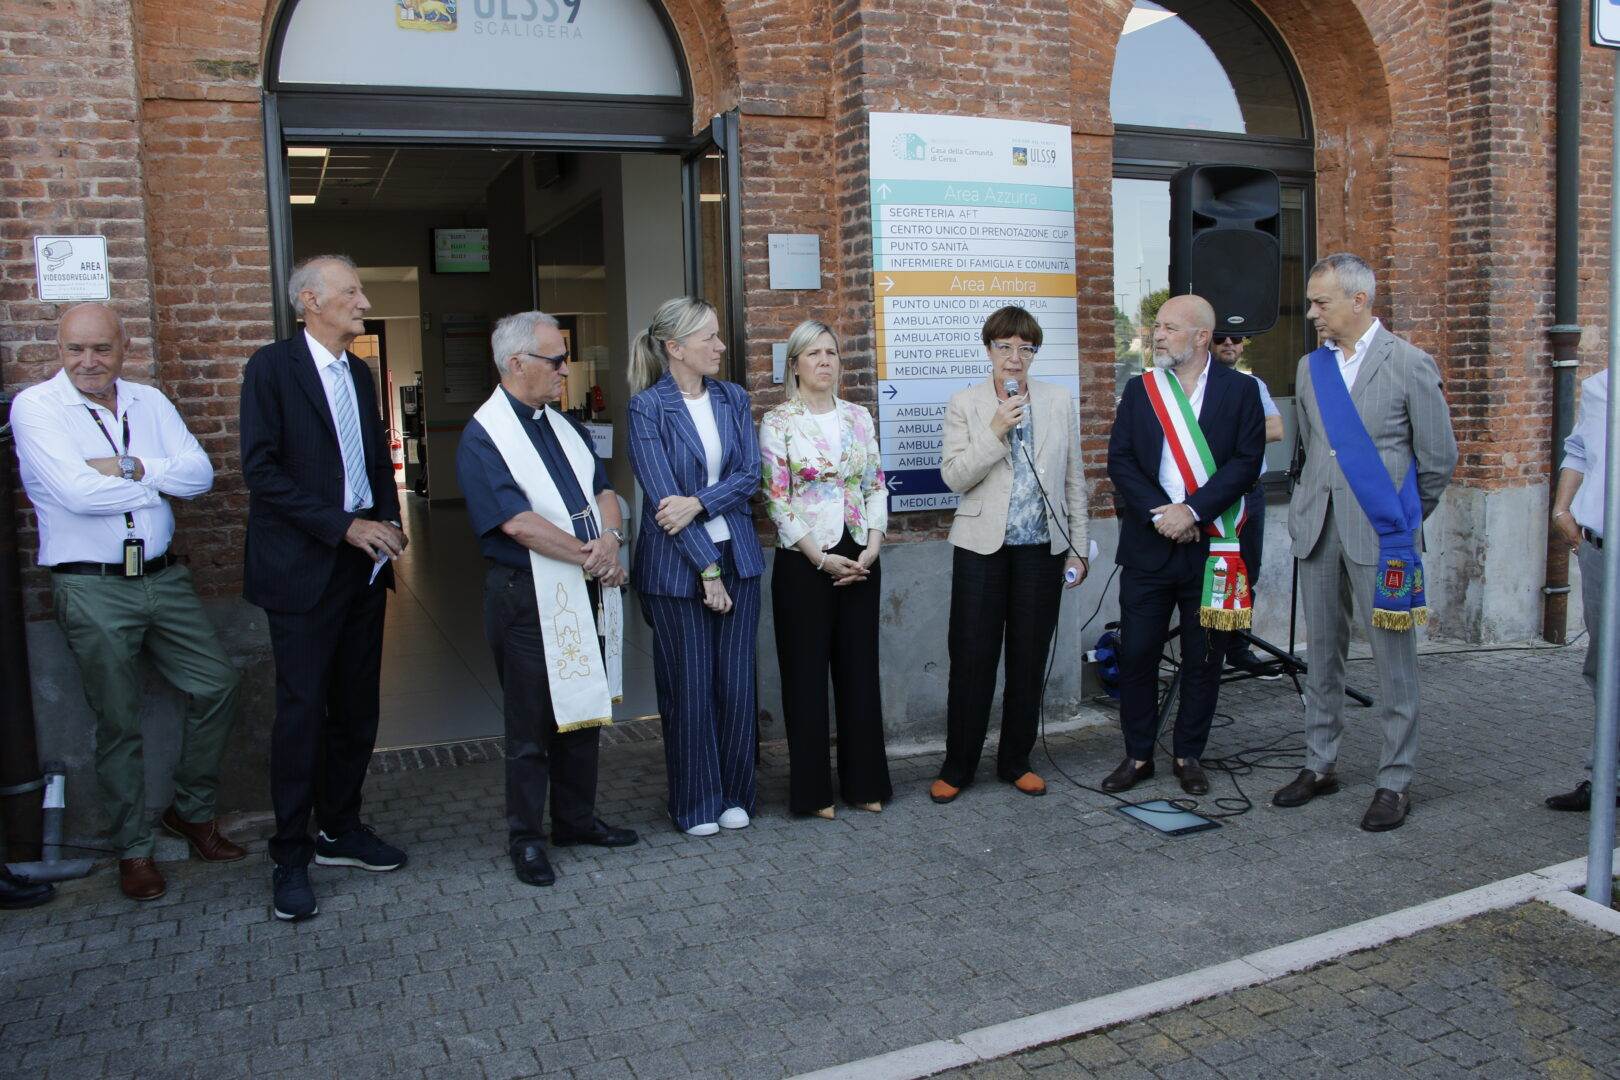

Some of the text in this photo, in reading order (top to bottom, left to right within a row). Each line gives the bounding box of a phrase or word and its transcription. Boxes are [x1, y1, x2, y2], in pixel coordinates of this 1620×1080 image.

[474, 21, 584, 40] SCALIGERA
[1030, 148, 1056, 164] ULSS9
[944, 185, 1038, 206] Area Azzurra
[890, 208, 978, 218] SEGRETERIA AFT
[890, 224, 1068, 239] CENTRO UNICO DI PRENOTAZIONE CUP
[890, 241, 968, 251] PUNTO SANITÀ
[81, 262, 101, 270] AREA
[891, 258, 1070, 270] INFERMIERE DI FAMIGLIA E COMUNITÀ
[950, 274, 1036, 292] Area Ambra
[892, 300, 1047, 308] PUNTO UNICO DI ACCESSO PUA
[894, 316, 970, 325] AMBULATORIO
[894, 332, 970, 342] AMBULATORIO
[895, 349, 979, 359] PUNTO PRELIEVI
[896, 364, 993, 376] MEDICINA PUBBLIC
[897, 406, 946, 416] AMBULAT
[898, 424, 942, 434] AMBULA
[898, 440, 943, 450] AMBULA
[899, 456, 942, 466] AMBULA
[900, 496, 960, 507] MEDICI AFT
